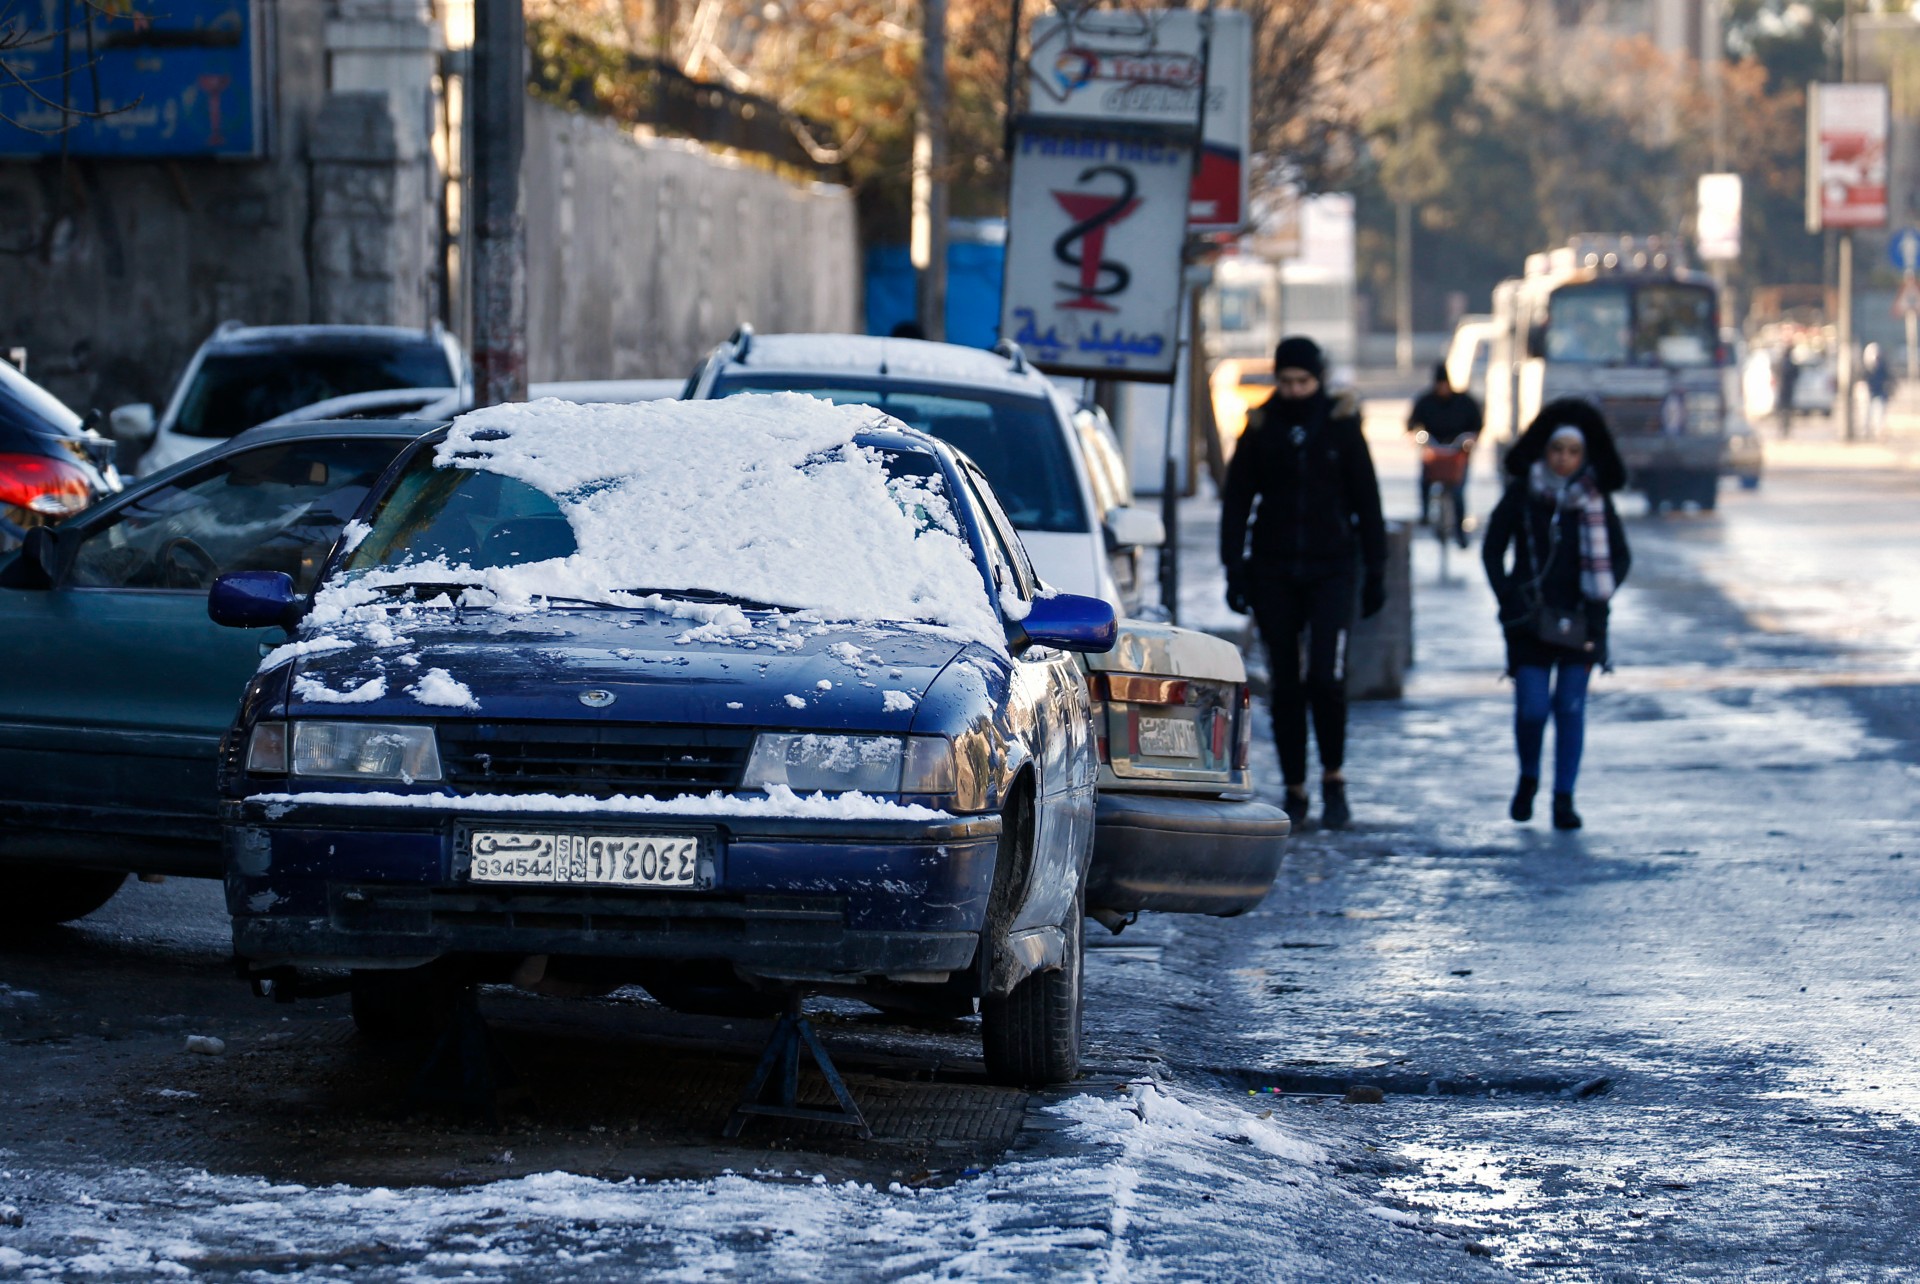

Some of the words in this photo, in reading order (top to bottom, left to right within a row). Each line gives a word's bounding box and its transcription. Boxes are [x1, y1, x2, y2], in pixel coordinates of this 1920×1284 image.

[1014, 308, 1164, 366] صيدية
[475, 836, 553, 857] دمشق
[557, 838, 571, 880] SYR
[477, 858, 553, 877] 934544
